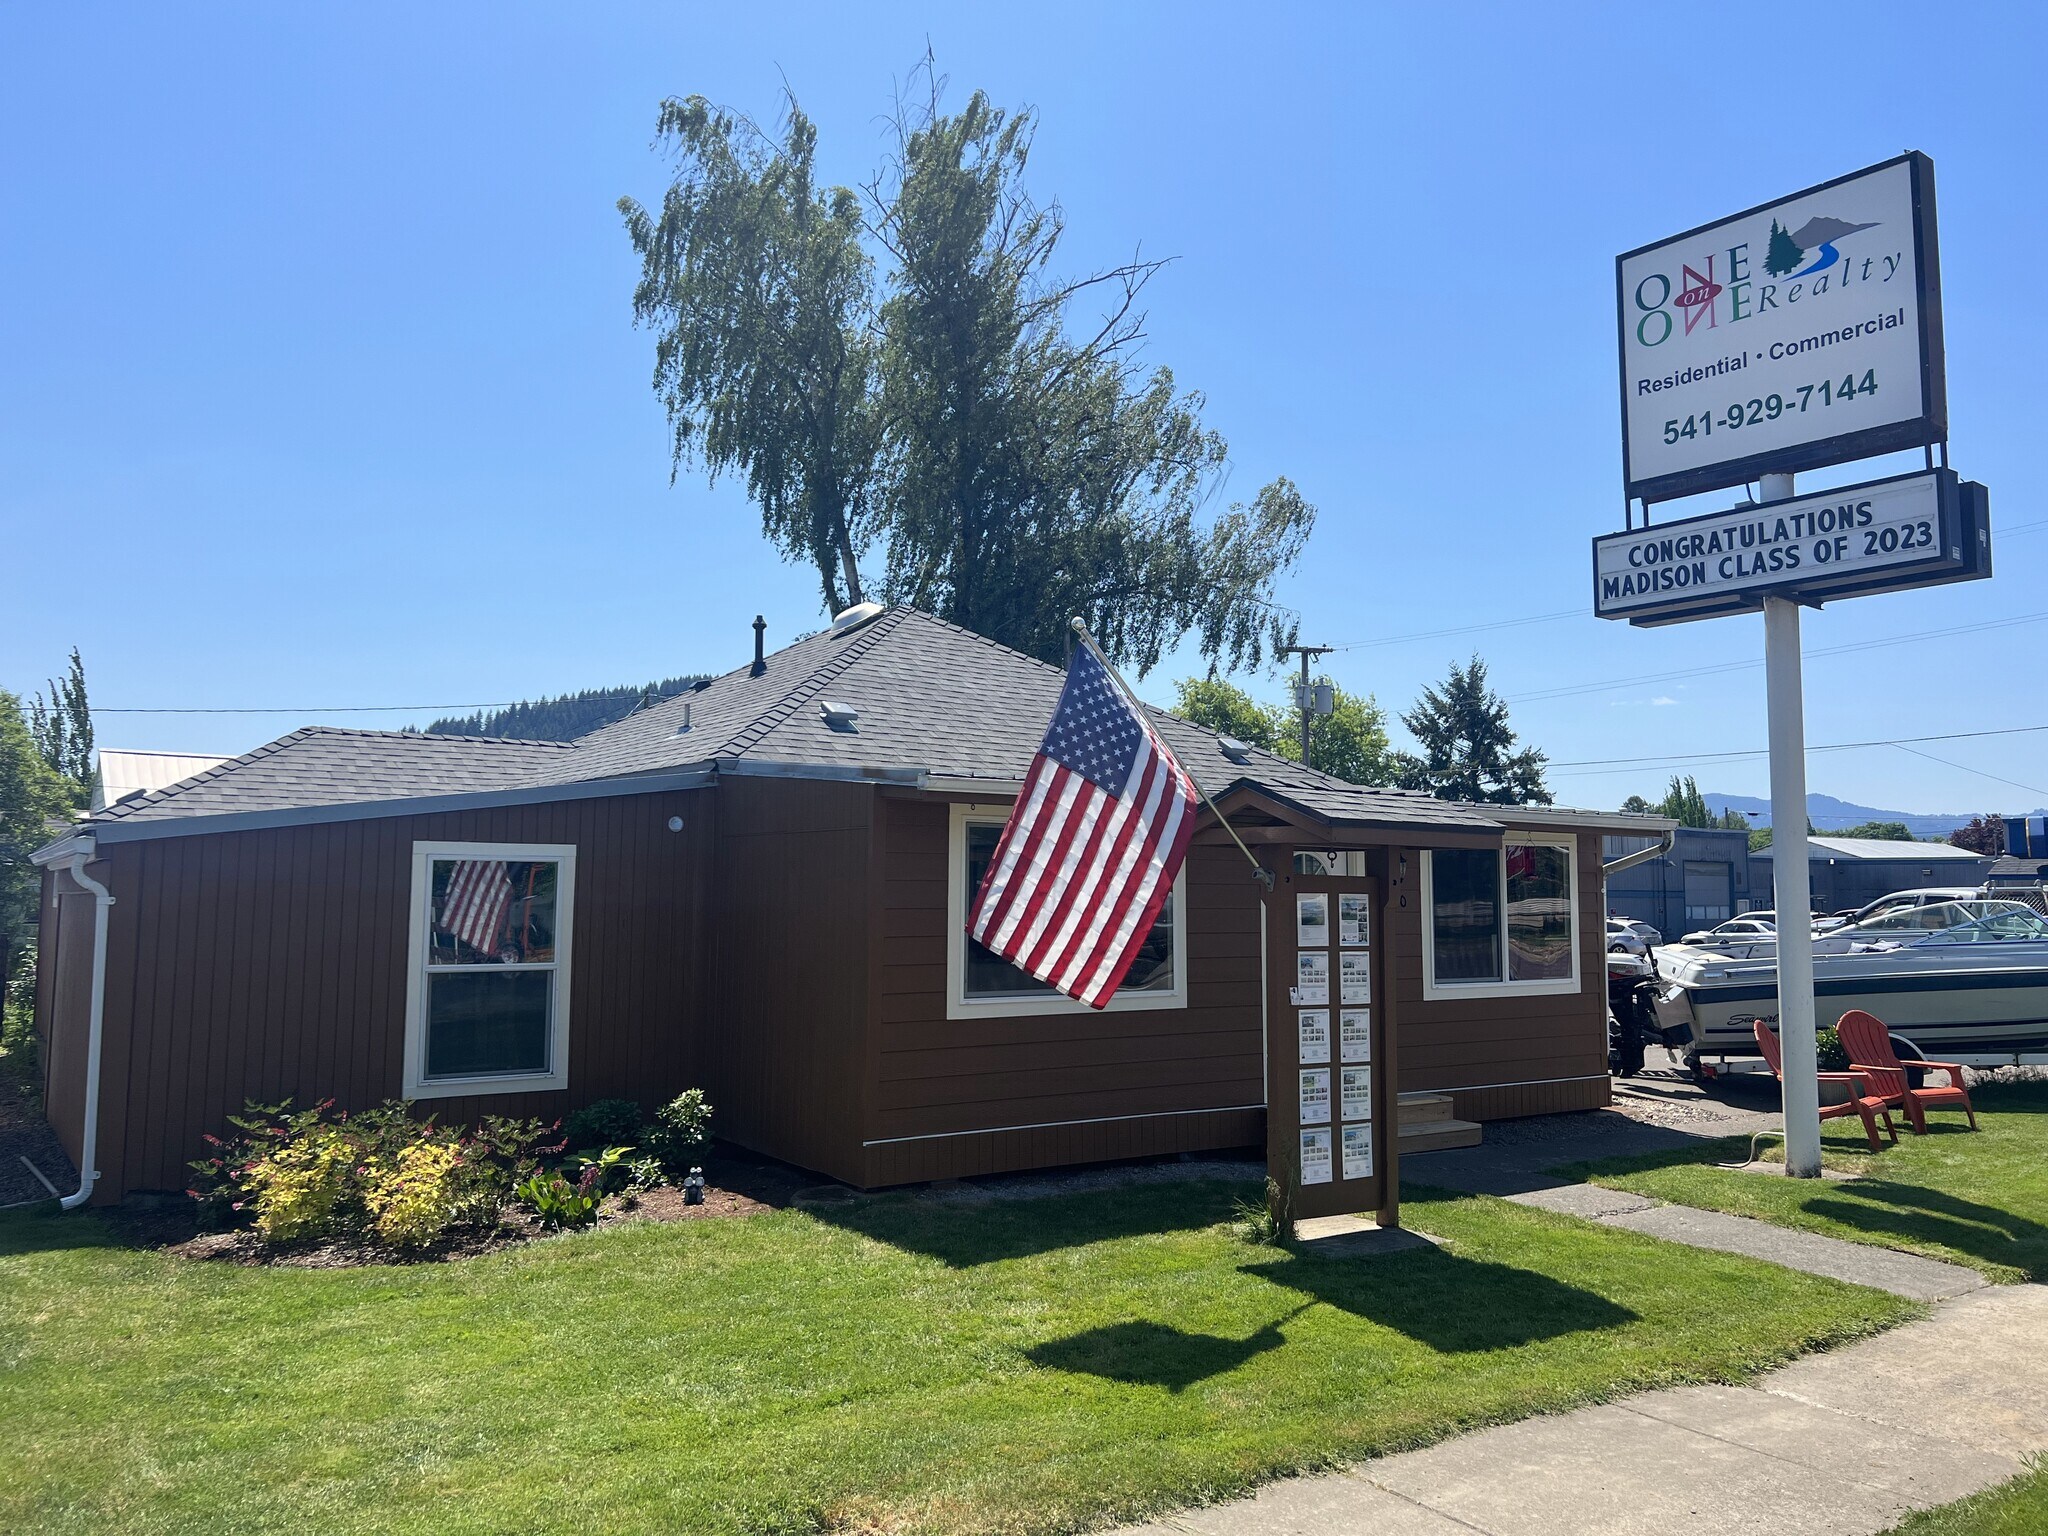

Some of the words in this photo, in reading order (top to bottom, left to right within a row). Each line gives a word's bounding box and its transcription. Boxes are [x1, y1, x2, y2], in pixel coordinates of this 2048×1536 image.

[1635, 242, 1751, 312] ONE
[1683, 287, 1710, 306] on
[1756, 251, 1902, 314] Realty
[1637, 351, 1748, 396] Residential
[1768, 307, 1905, 361] Commercial
[1663, 368, 1879, 446] 541-929-7144
[1602, 560, 1706, 600] MADISON
[1718, 544, 1801, 580] CLASS
[1813, 535, 1849, 564] OF
[1863, 521, 1933, 556] 2023
[1628, 501, 1873, 568] CONGRATULATIONS
